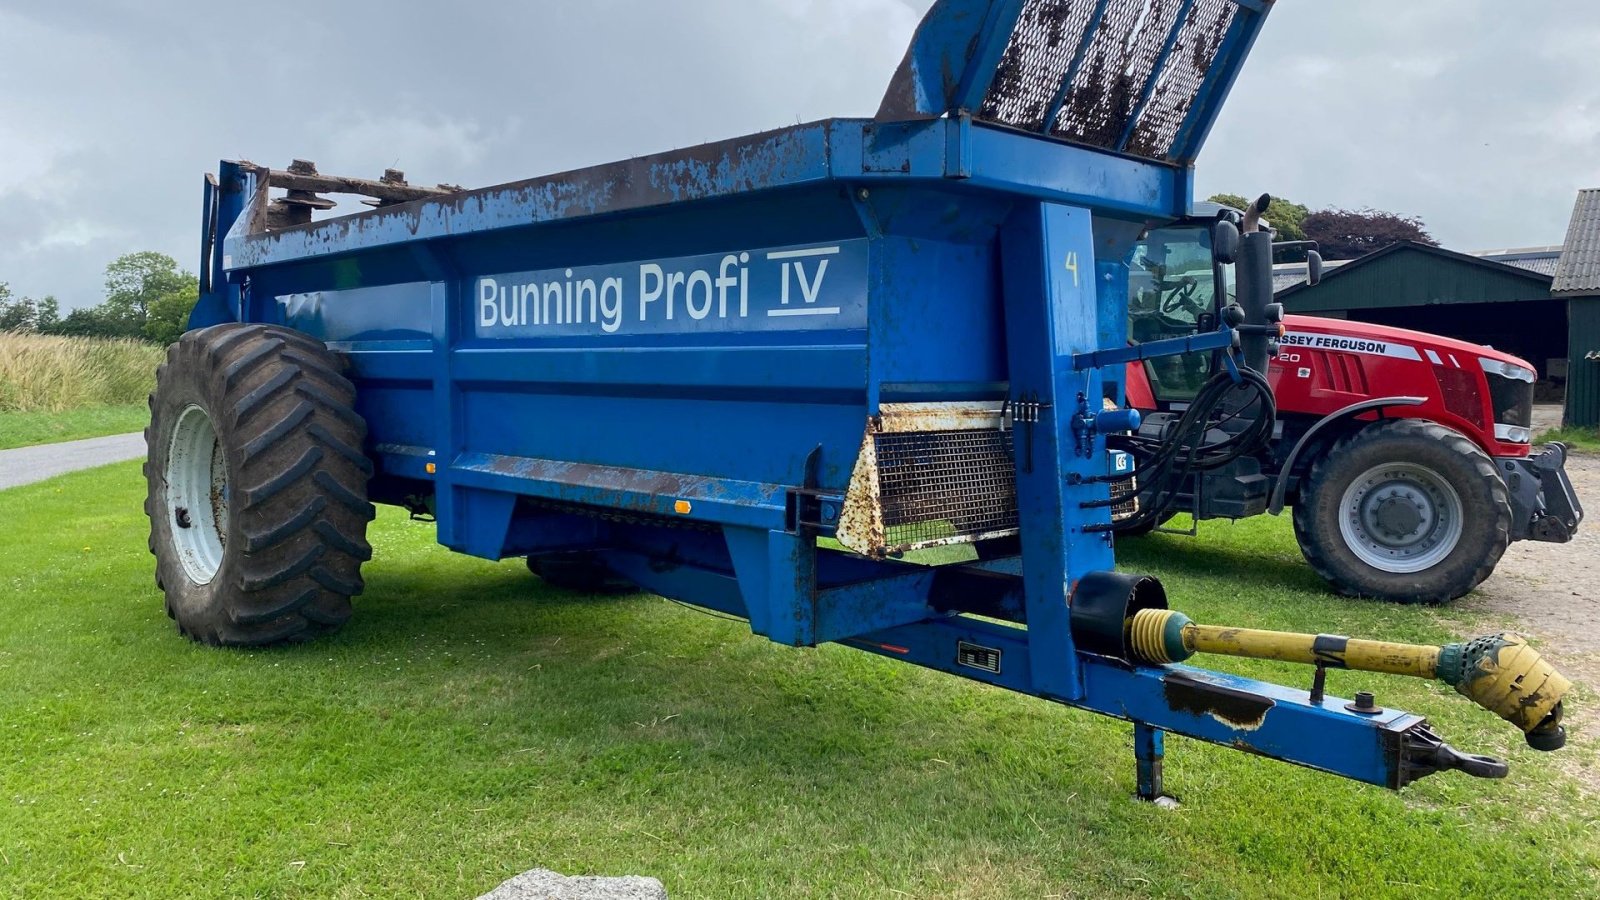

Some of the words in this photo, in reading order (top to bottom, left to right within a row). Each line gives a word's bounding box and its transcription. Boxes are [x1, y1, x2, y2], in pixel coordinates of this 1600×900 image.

[1065, 251, 1078, 288] 4
[480, 268, 623, 333] Bunning
[639, 252, 750, 321] Profi
[781, 259, 829, 304] IV
[1274, 335, 1313, 345] ASSEY
[1316, 337, 1386, 353] FERGUSON
